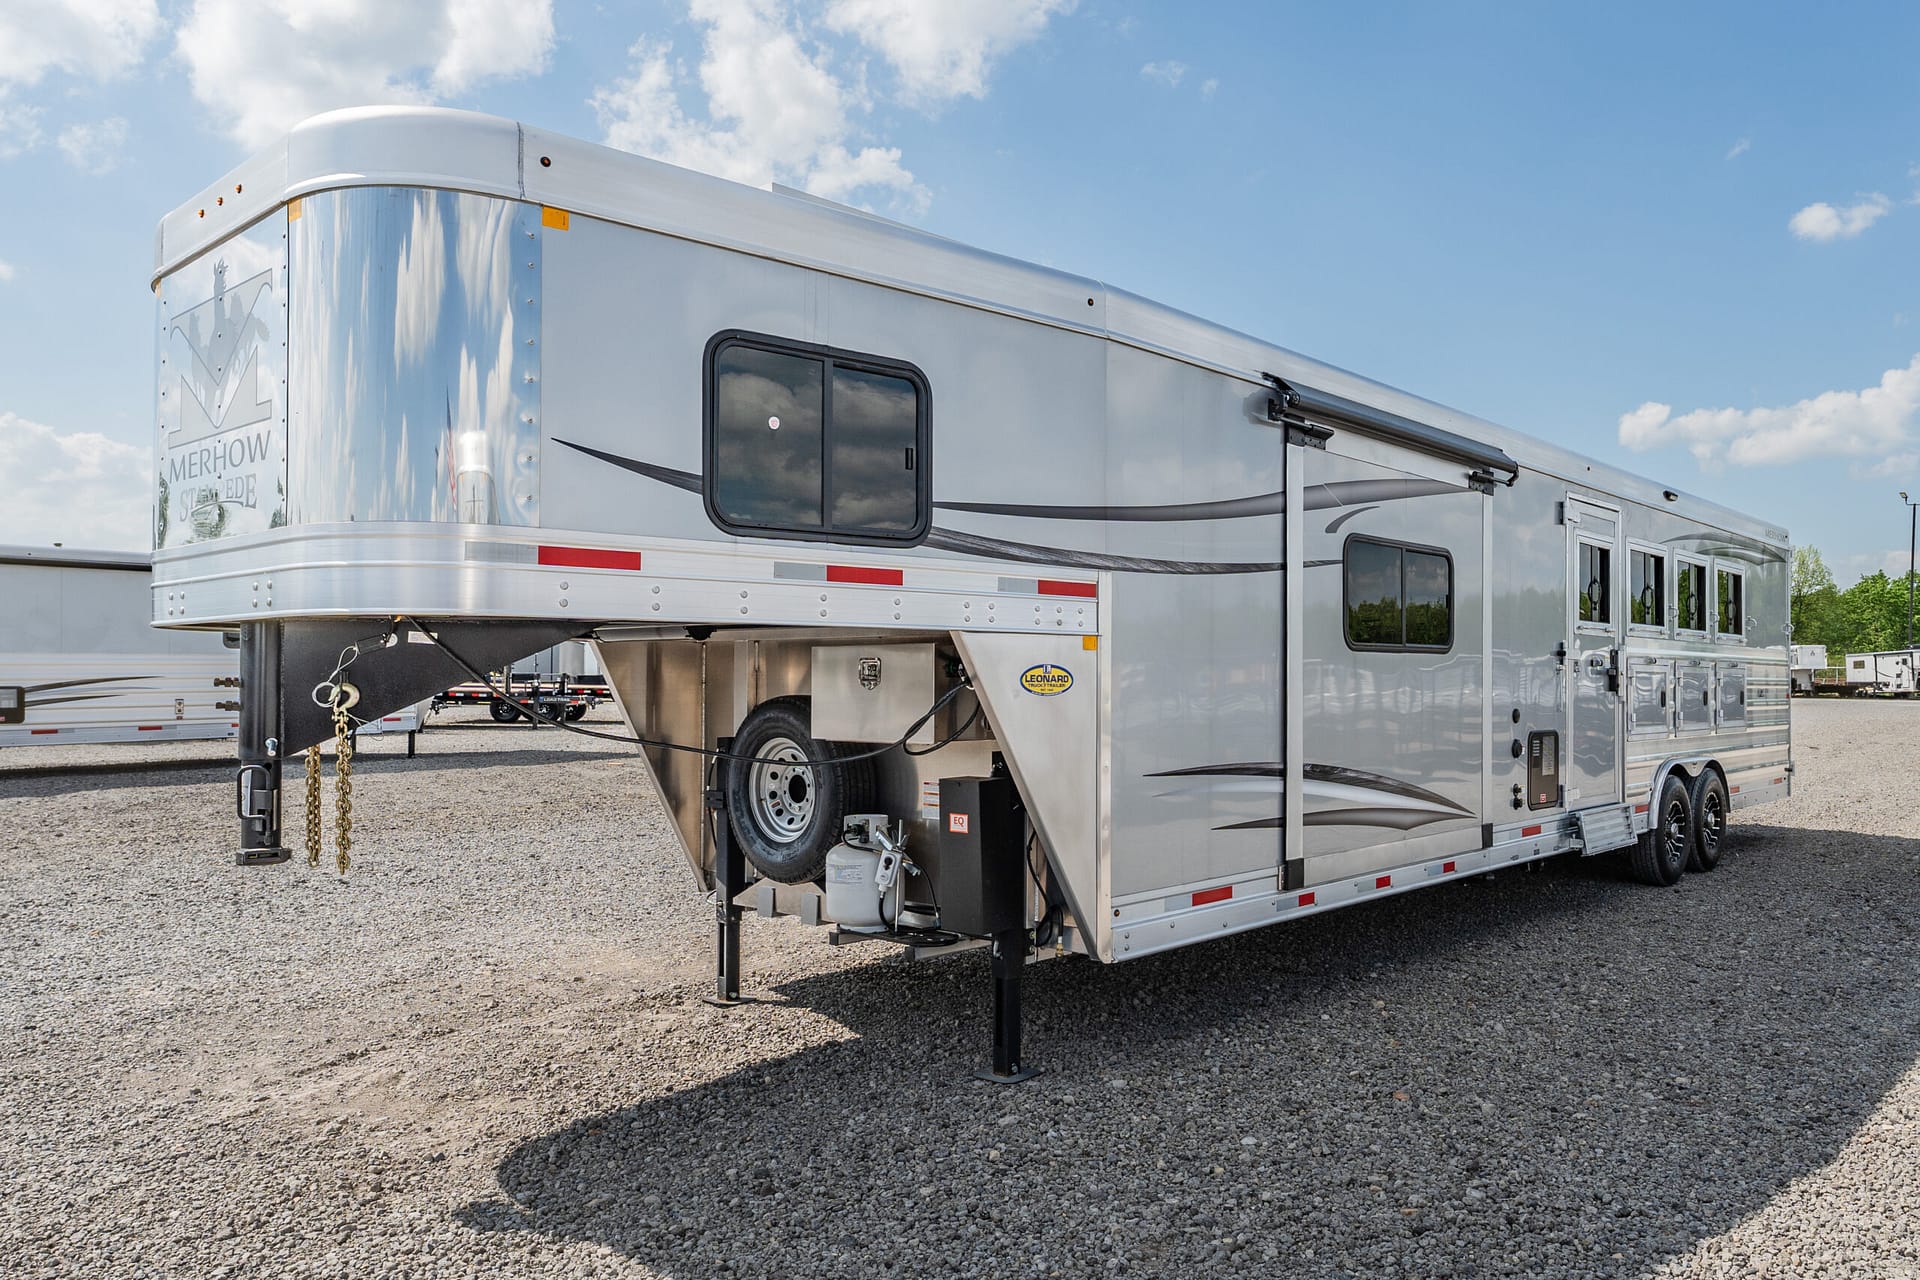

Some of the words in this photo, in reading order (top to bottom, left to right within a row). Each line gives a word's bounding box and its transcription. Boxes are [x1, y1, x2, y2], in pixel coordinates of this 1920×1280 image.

[169, 430, 271, 484] MERHOW
[1025, 675, 1069, 683] LEONARD
[953, 816, 965, 827] EQ
